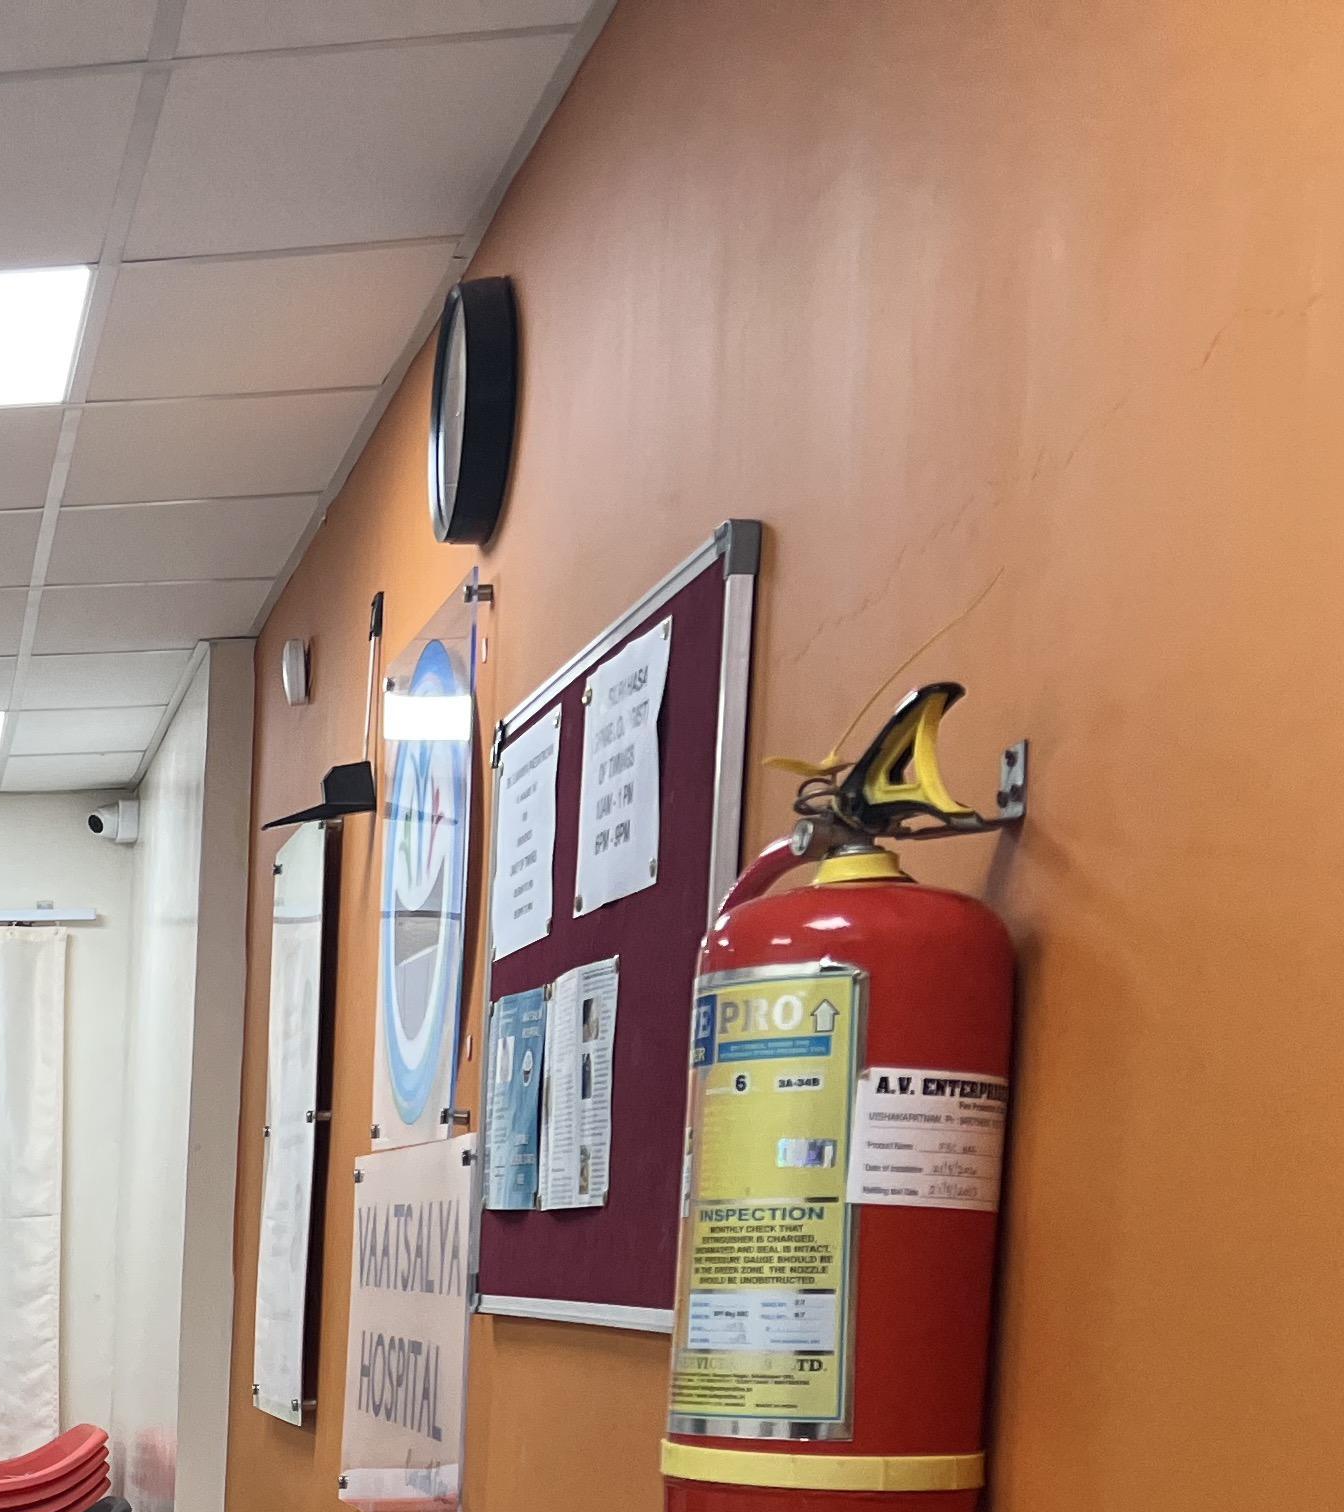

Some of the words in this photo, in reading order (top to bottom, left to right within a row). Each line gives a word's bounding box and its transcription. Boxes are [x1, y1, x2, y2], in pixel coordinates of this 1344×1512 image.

[719, 995, 804, 1033] PRO
[735, 1074, 747, 1092] 6
[876, 1076, 915, 1095] A.V.
[700, 1207, 825, 1222] INSPECTION
[745, 1224, 777, 1233] CHECK
[779, 1224, 804, 1232] THAT
[358, 1199, 461, 1297] VAATSALYA
[743, 1256, 775, 1264] GAUGE
[778, 1256, 817, 1264] SHOULD
[358, 1329, 443, 1442] HOSPITAL
